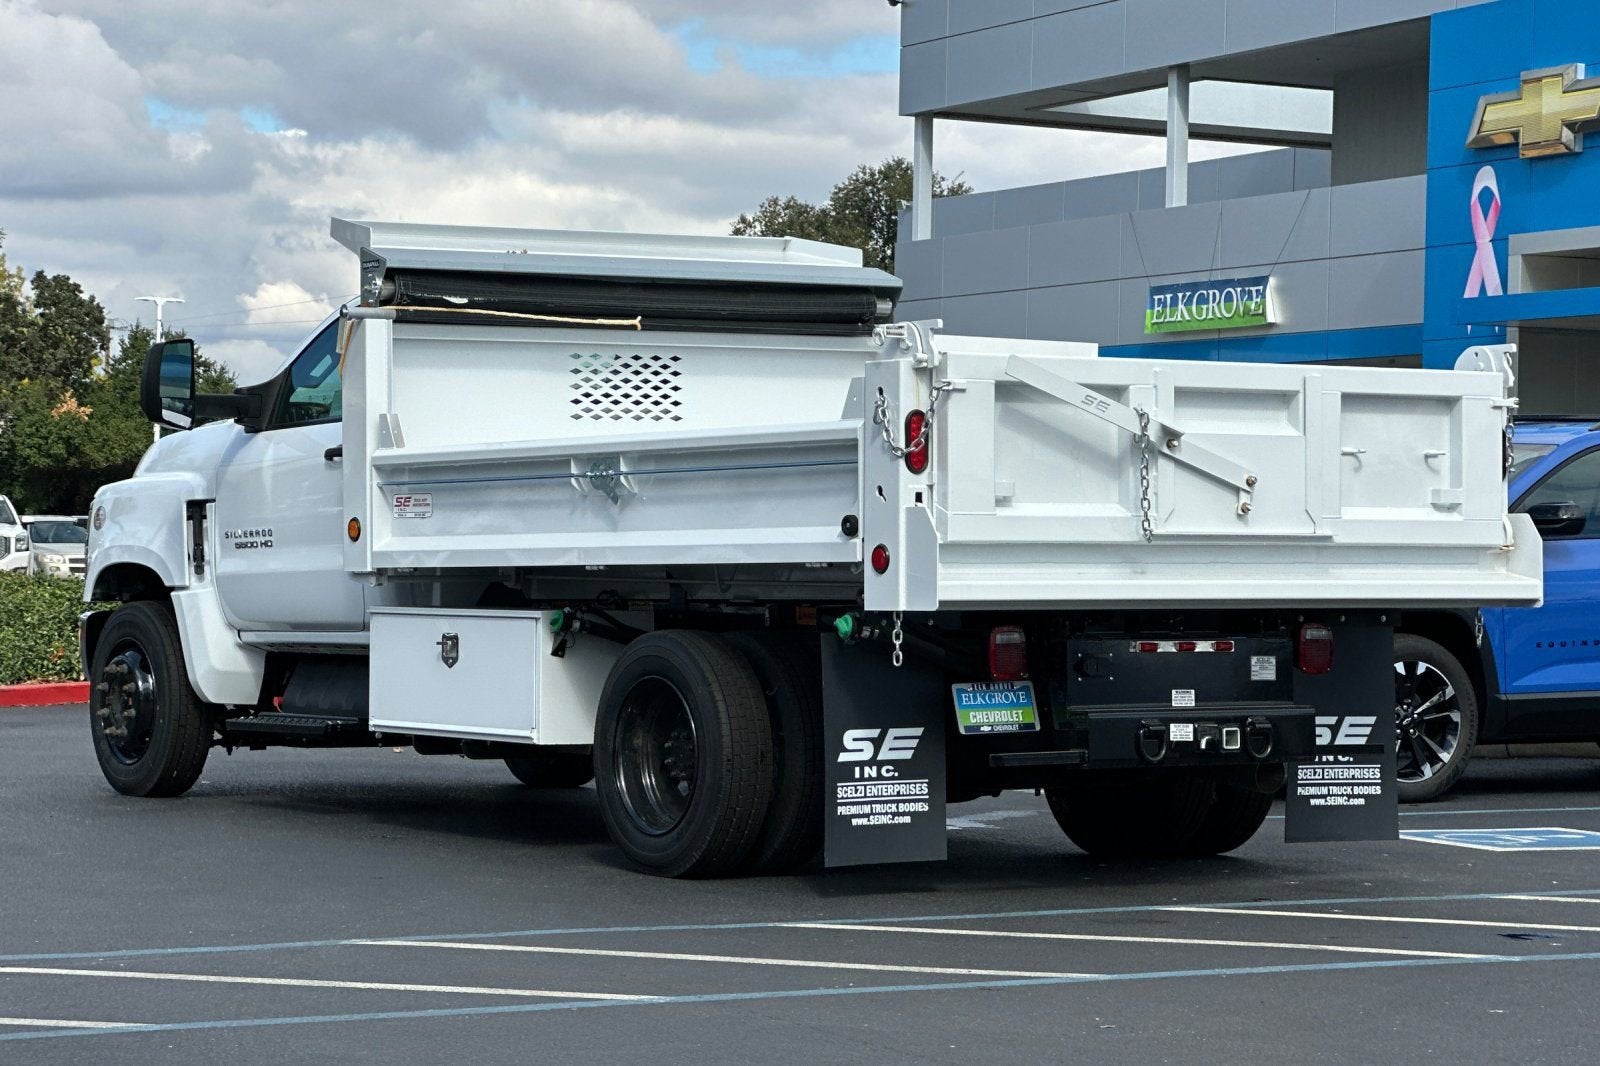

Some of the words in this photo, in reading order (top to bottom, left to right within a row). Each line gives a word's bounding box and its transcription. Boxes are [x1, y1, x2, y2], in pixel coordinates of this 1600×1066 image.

[1081, 394, 1111, 413] SE
[394, 496, 412, 507] SE
[224, 528, 273, 539] SILVERADO
[234, 541, 258, 549] 5500
[259, 539, 273, 548] HD
[969, 710, 1023, 723] CHEVROLET
[837, 727, 925, 762] SE
[854, 765, 899, 779] INC.
[1297, 768, 1323, 780] SCELZI
[1323, 768, 1381, 779] ENTERPRISES
[836, 785, 865, 799] SCELZI
[866, 783, 929, 797] ENTERPRISES
[1297, 786, 1328, 796] PREMIUM
[1329, 786, 1353, 795] TRUCK
[1353, 785, 1382, 795] BODIES
[1309, 796, 1366, 806] www.SEINC.com
[837, 804, 871, 816] PREMIUM
[871, 803, 898, 814] TRUCK
[898, 801, 929, 813] BODIES
[851, 814, 912, 826] www.SEINC.com
